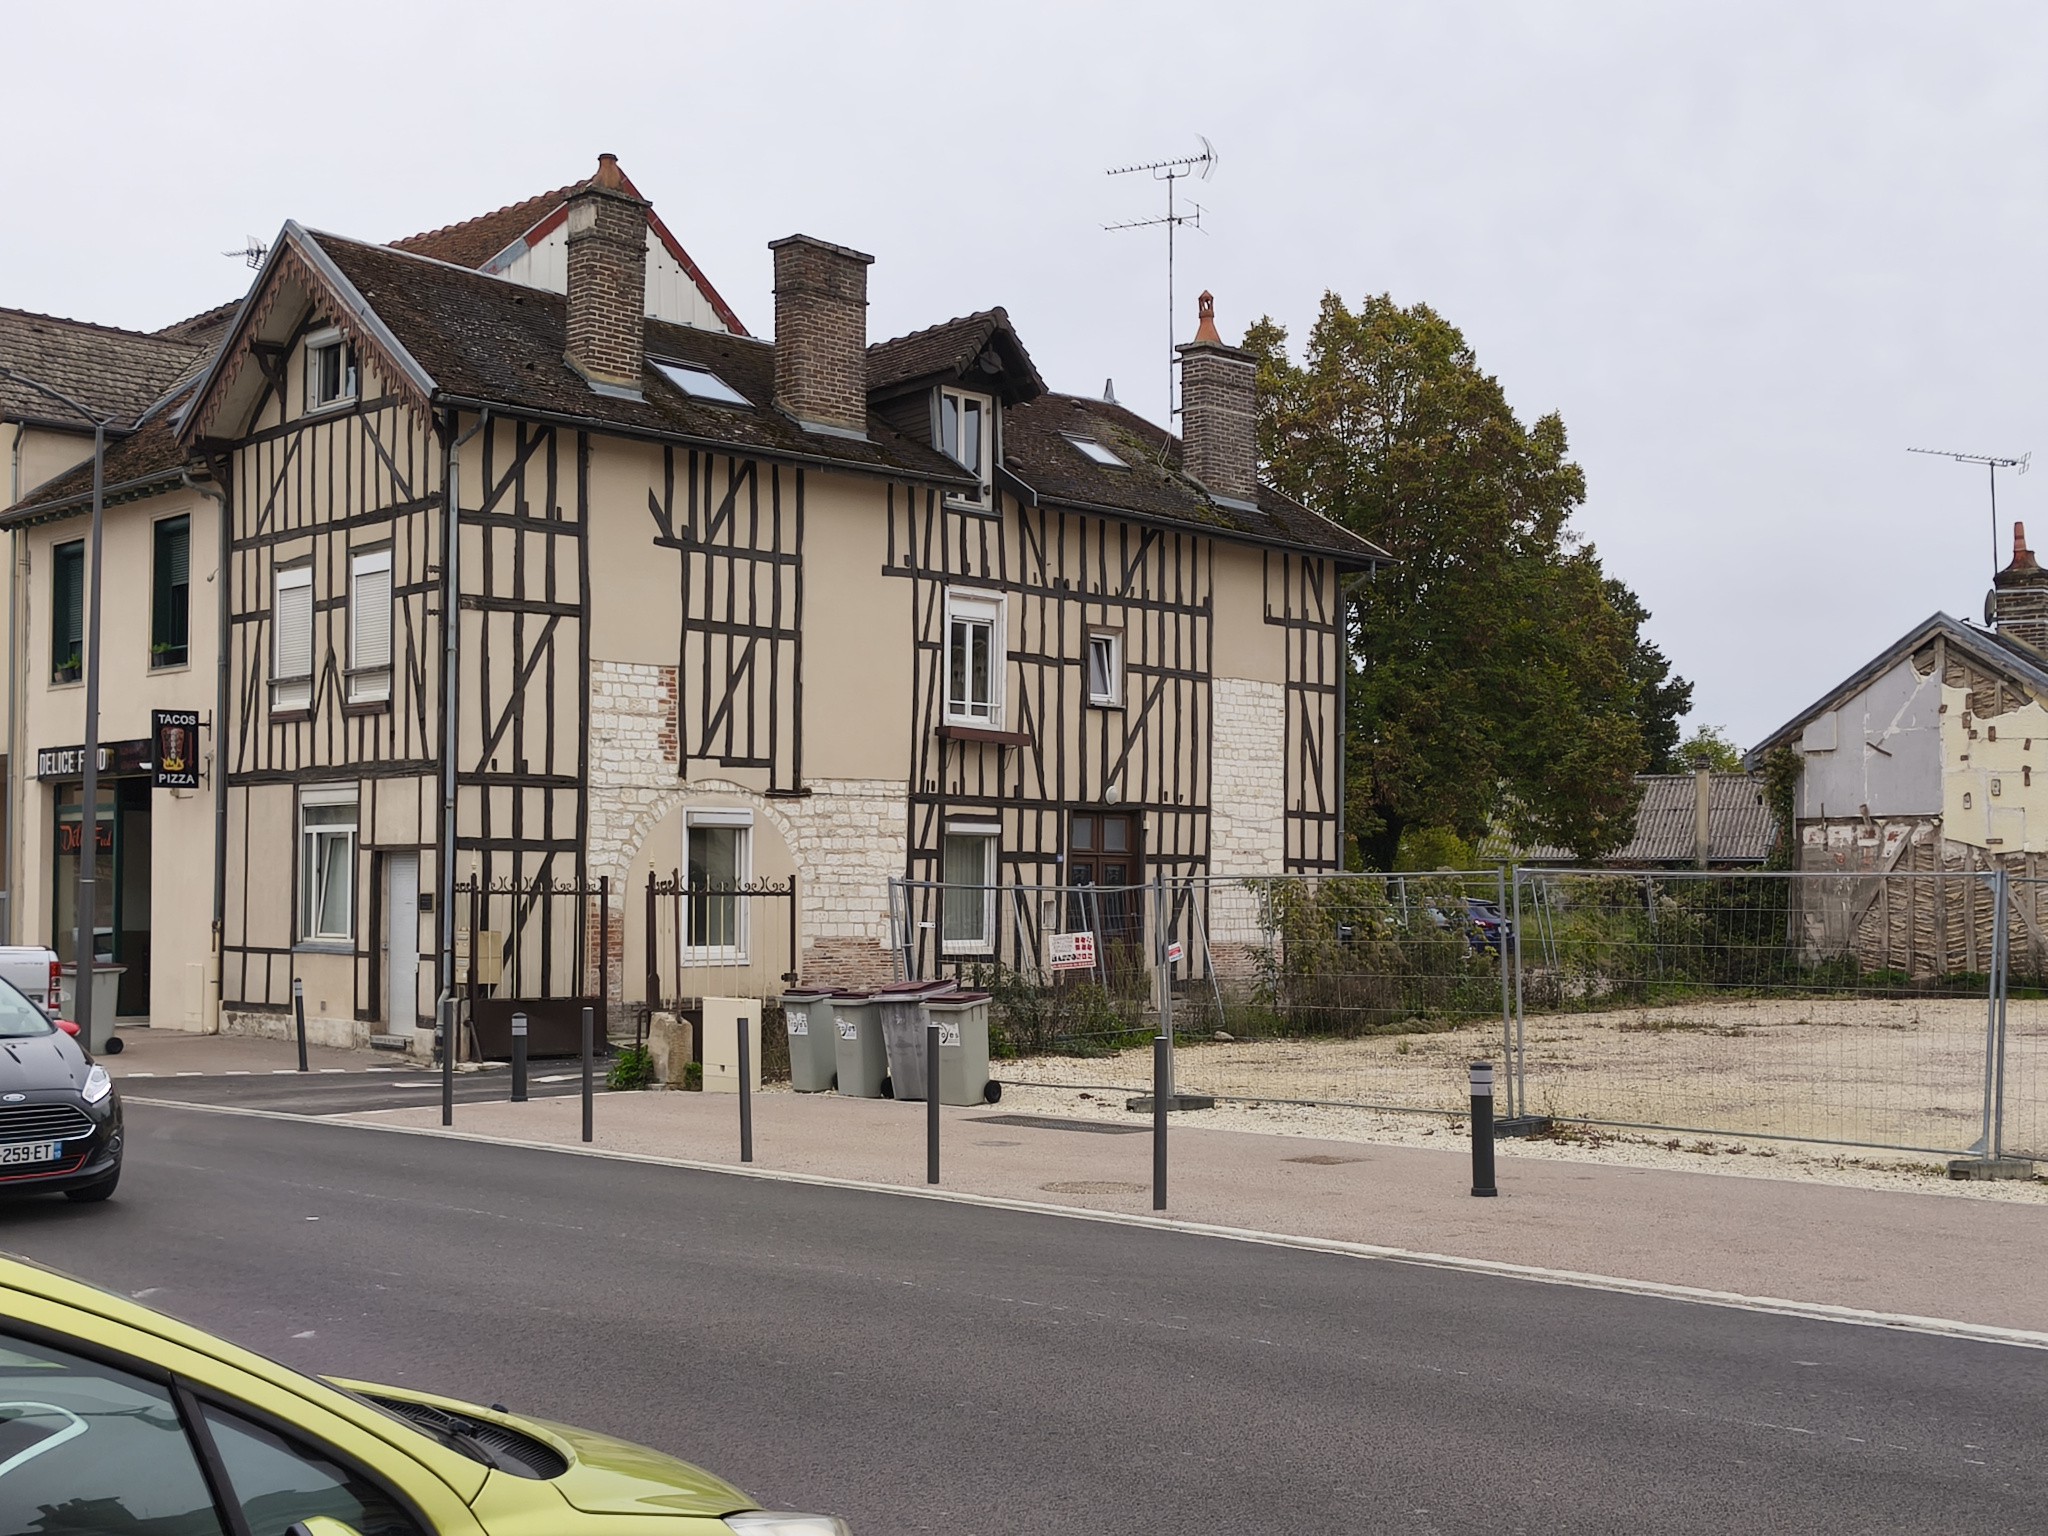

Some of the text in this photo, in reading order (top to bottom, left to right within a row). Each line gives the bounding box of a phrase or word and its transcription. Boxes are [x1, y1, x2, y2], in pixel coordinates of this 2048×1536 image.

[158, 714, 196, 725] TACOS
[39, 750, 75, 776] DELICE
[77, 748, 107, 773] FD
[158, 773, 195, 784] PIZZA
